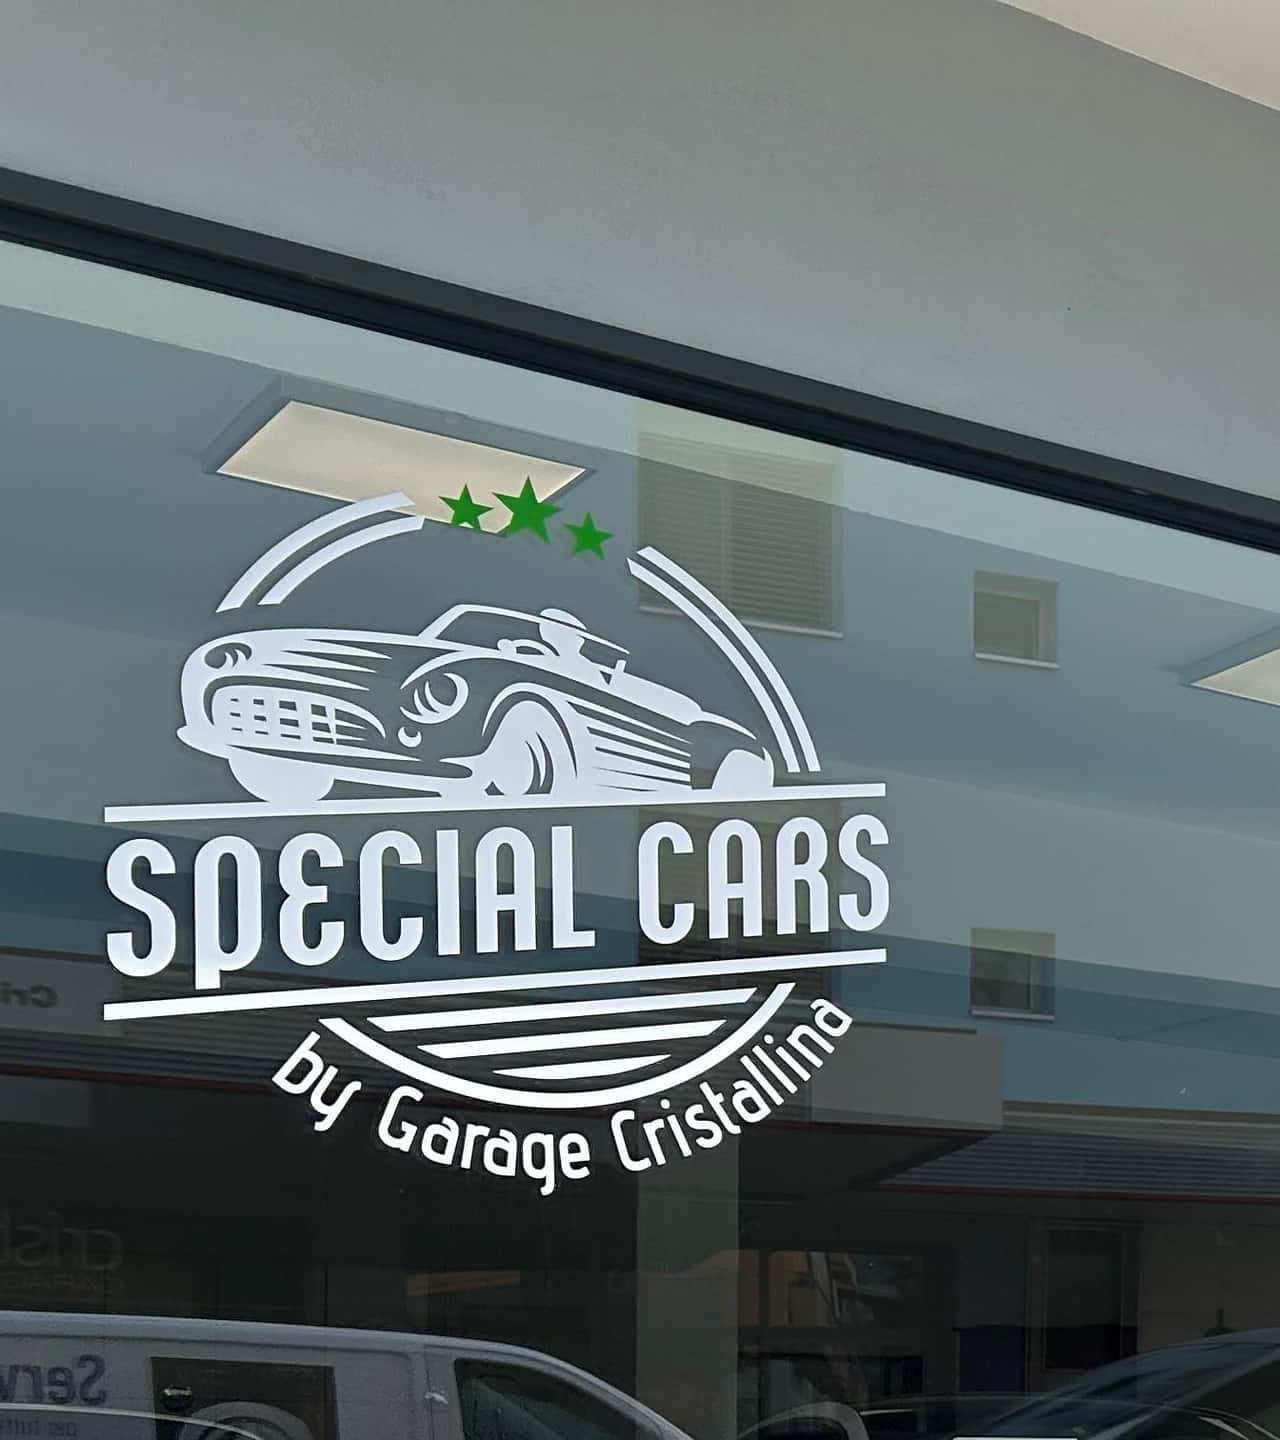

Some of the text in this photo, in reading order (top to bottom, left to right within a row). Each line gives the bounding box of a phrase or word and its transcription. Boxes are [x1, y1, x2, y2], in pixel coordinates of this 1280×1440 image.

[105, 813, 891, 990] SPECIAL CARS
[271, 997, 854, 1197] by Garage Cristallina
